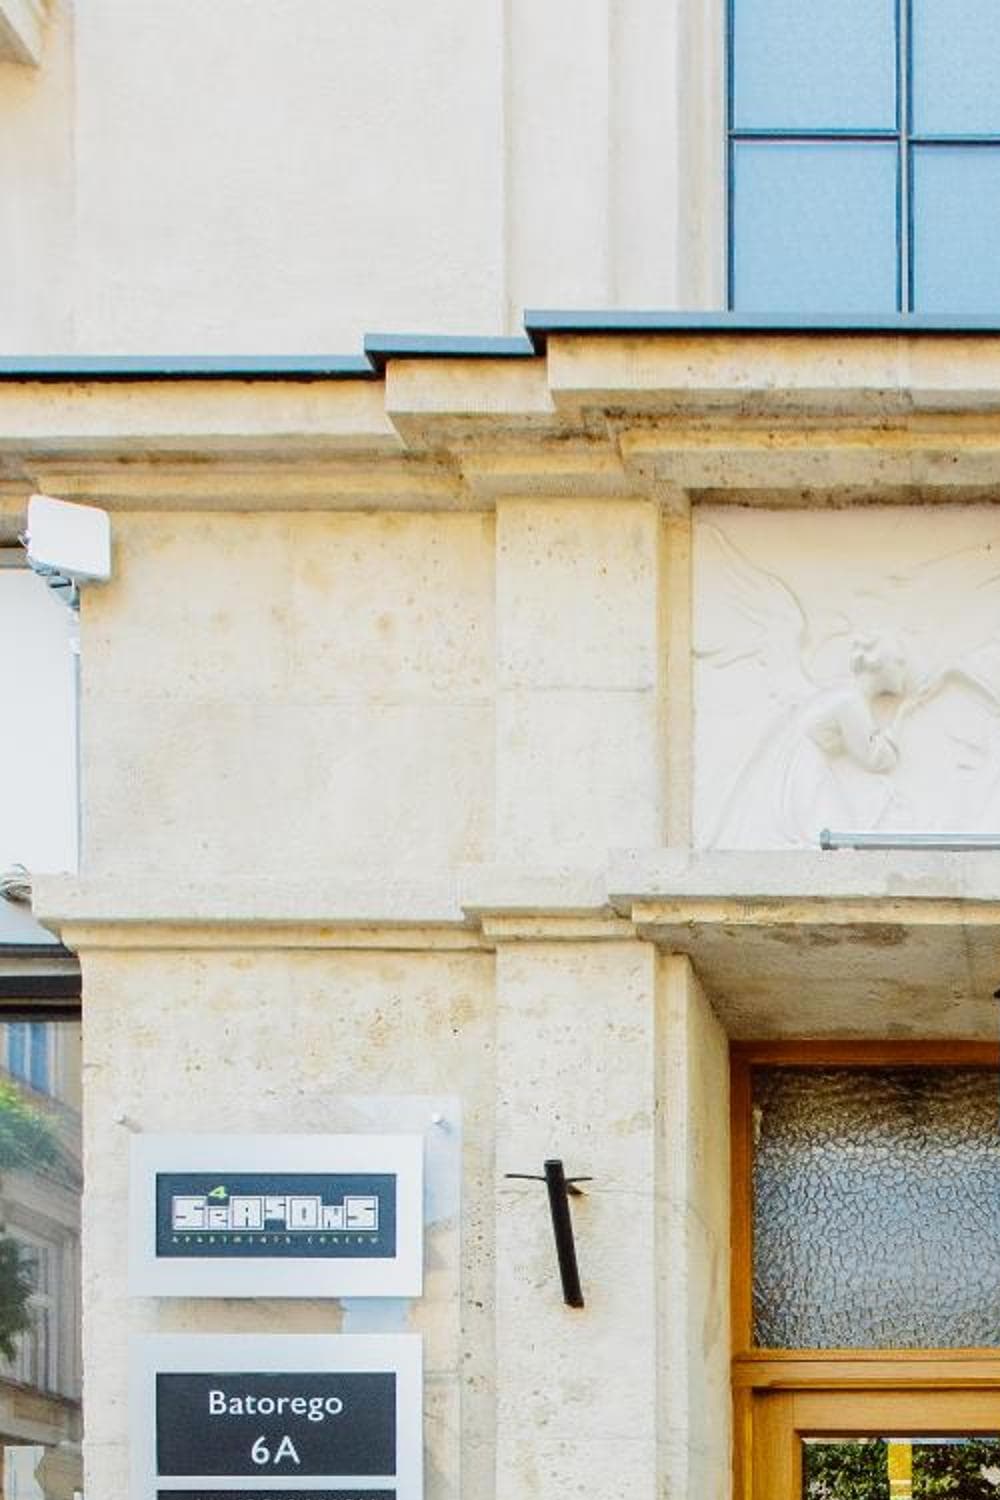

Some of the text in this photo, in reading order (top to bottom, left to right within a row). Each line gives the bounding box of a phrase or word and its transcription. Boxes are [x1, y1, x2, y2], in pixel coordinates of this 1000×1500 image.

[208, 1185, 228, 1198] 4
[208, 1390, 343, 1421] Batorego
[251, 1435, 301, 1464] 6A
